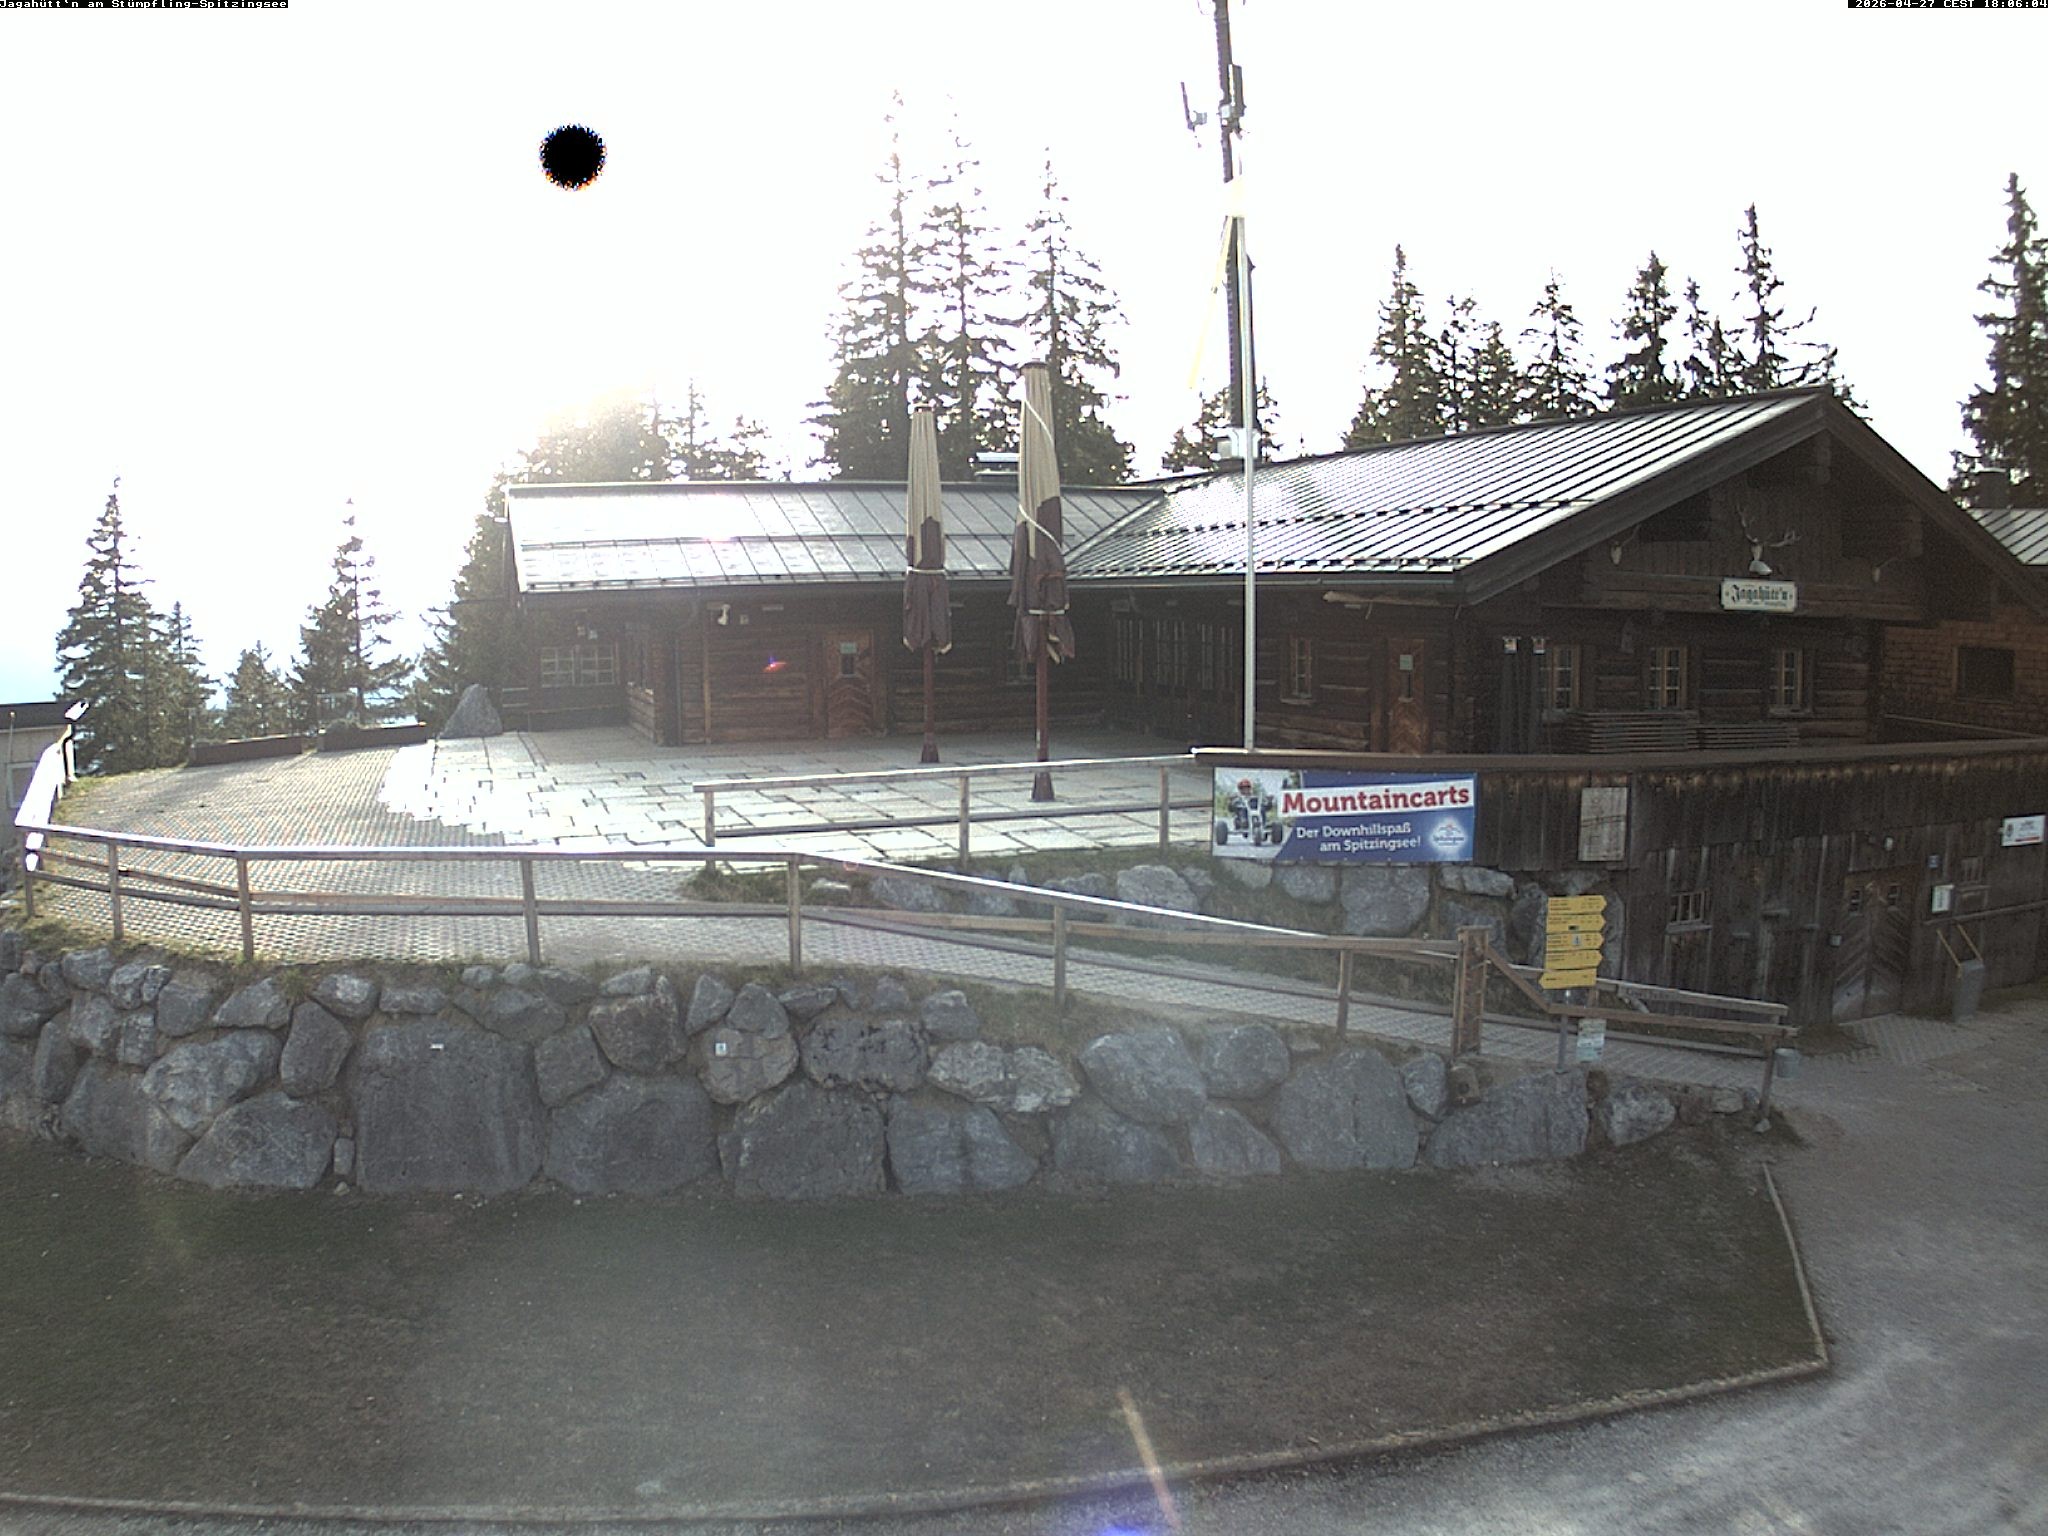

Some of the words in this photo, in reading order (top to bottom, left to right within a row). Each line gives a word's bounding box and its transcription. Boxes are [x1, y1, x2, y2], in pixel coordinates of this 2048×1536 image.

[1281, 785, 1470, 815] Mountaincarts
[1296, 826, 1319, 838] Der
[1322, 822, 1411, 837] Downhillspaß
[1320, 841, 1341, 852] am
[1343, 835, 1421, 853] Spitzingsee!
